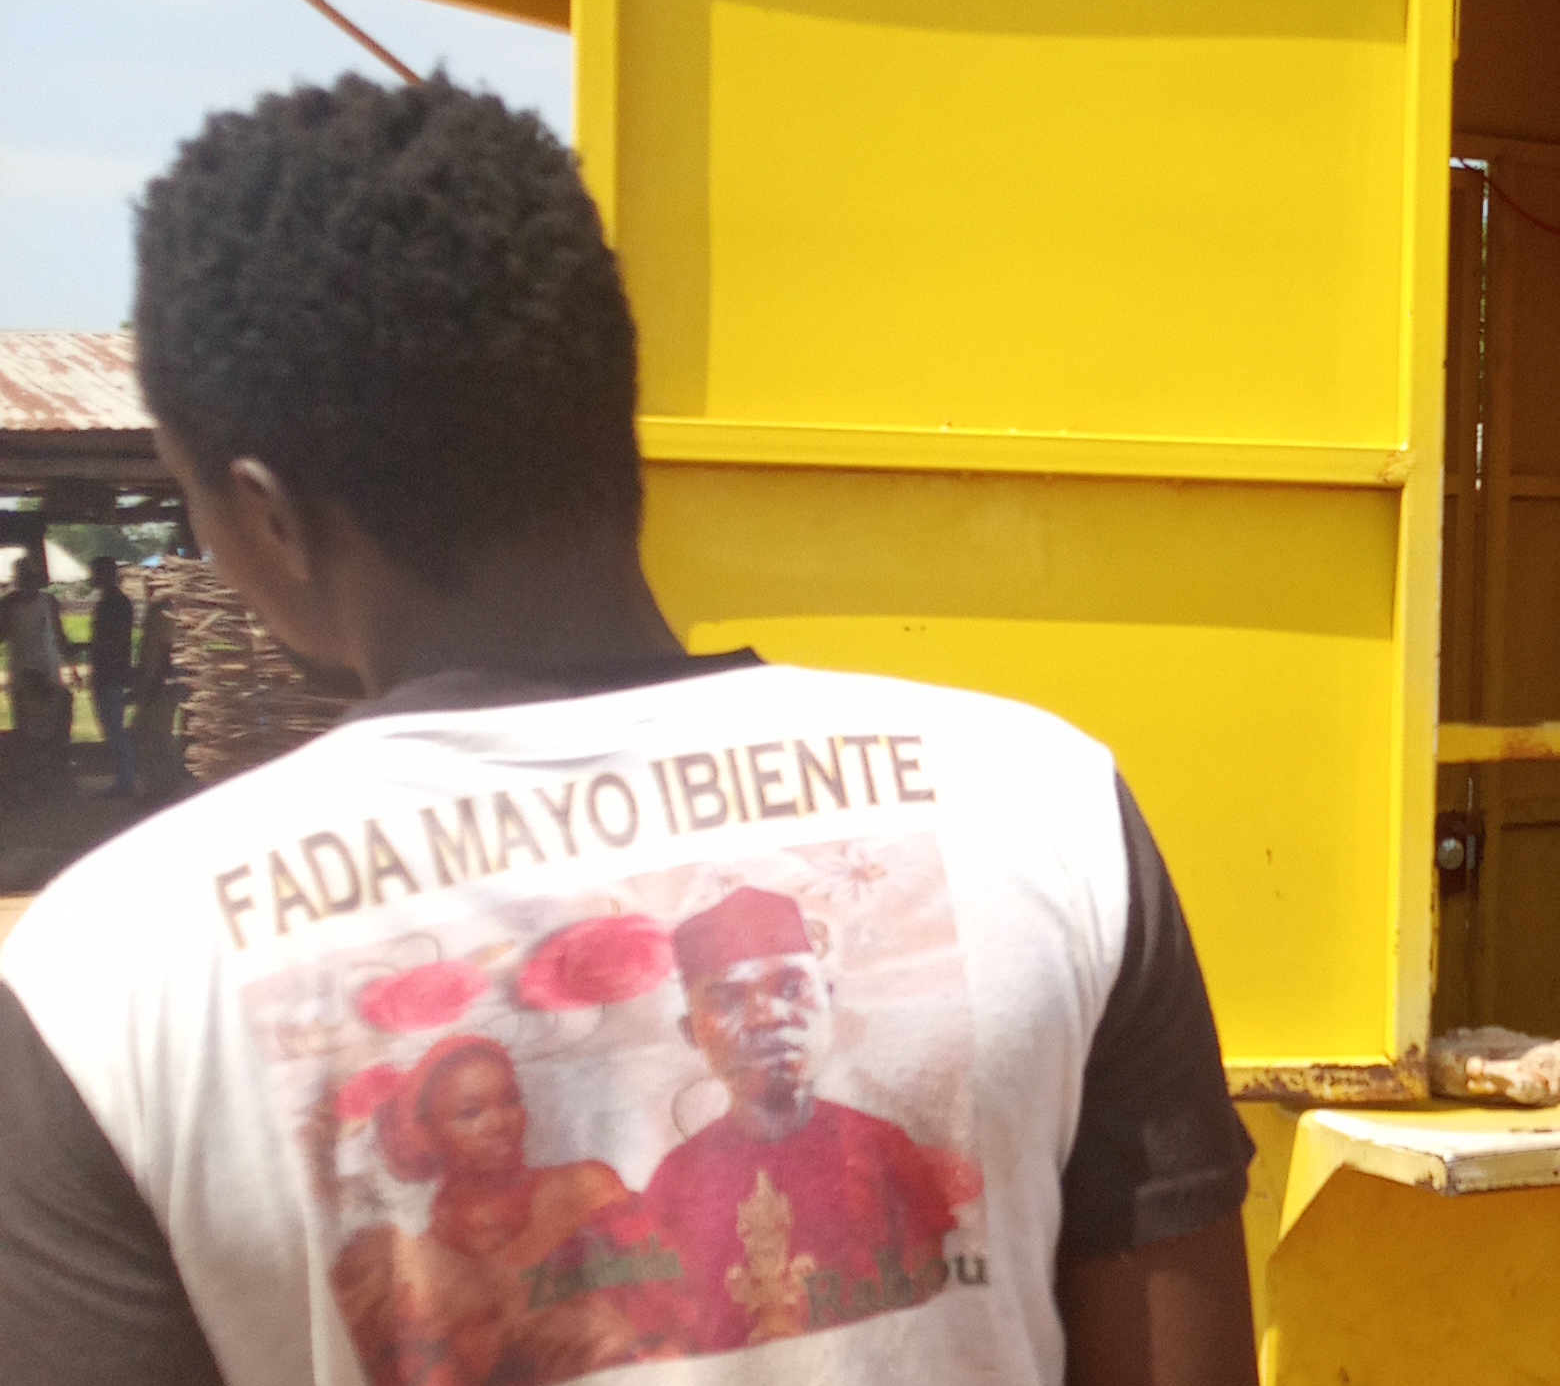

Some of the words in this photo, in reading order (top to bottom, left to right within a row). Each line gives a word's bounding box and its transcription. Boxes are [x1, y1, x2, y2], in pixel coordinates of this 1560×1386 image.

[213, 819, 423, 951] FADA
[417, 771, 642, 889] MAYO
[649, 735, 937, 836] IBIENTE
